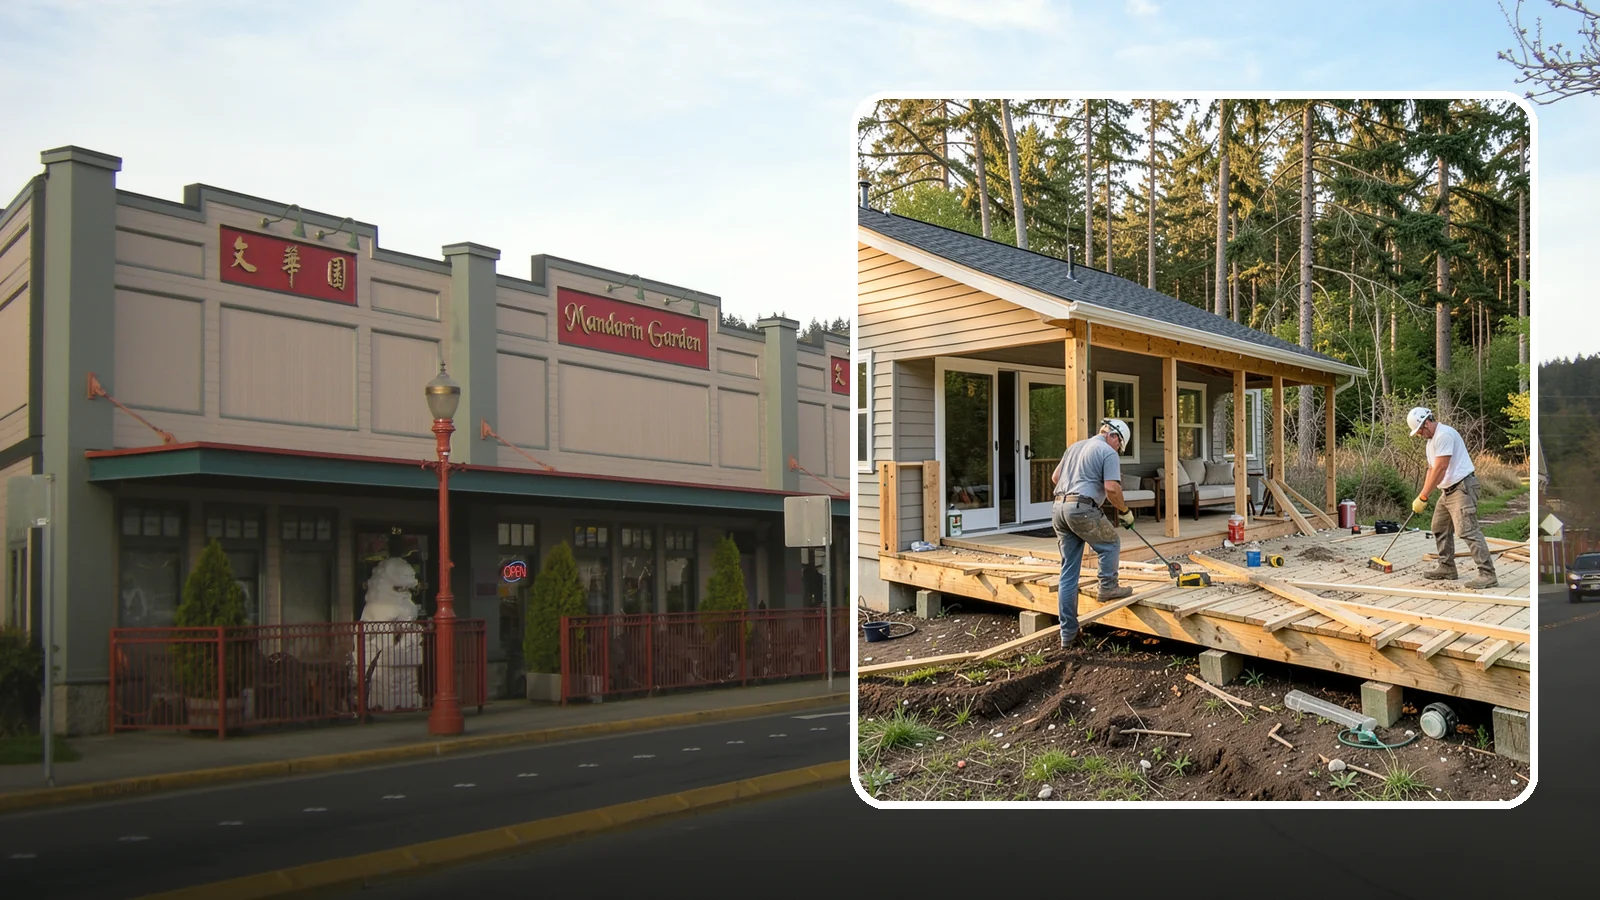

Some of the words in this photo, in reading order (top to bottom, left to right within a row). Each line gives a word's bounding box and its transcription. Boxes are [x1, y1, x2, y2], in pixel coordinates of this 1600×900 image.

[231, 236, 346, 291] 文華園
[564, 302, 644, 341] Mandarin
[647, 320, 702, 352] Garden
[503, 565, 527, 578] OPEN
